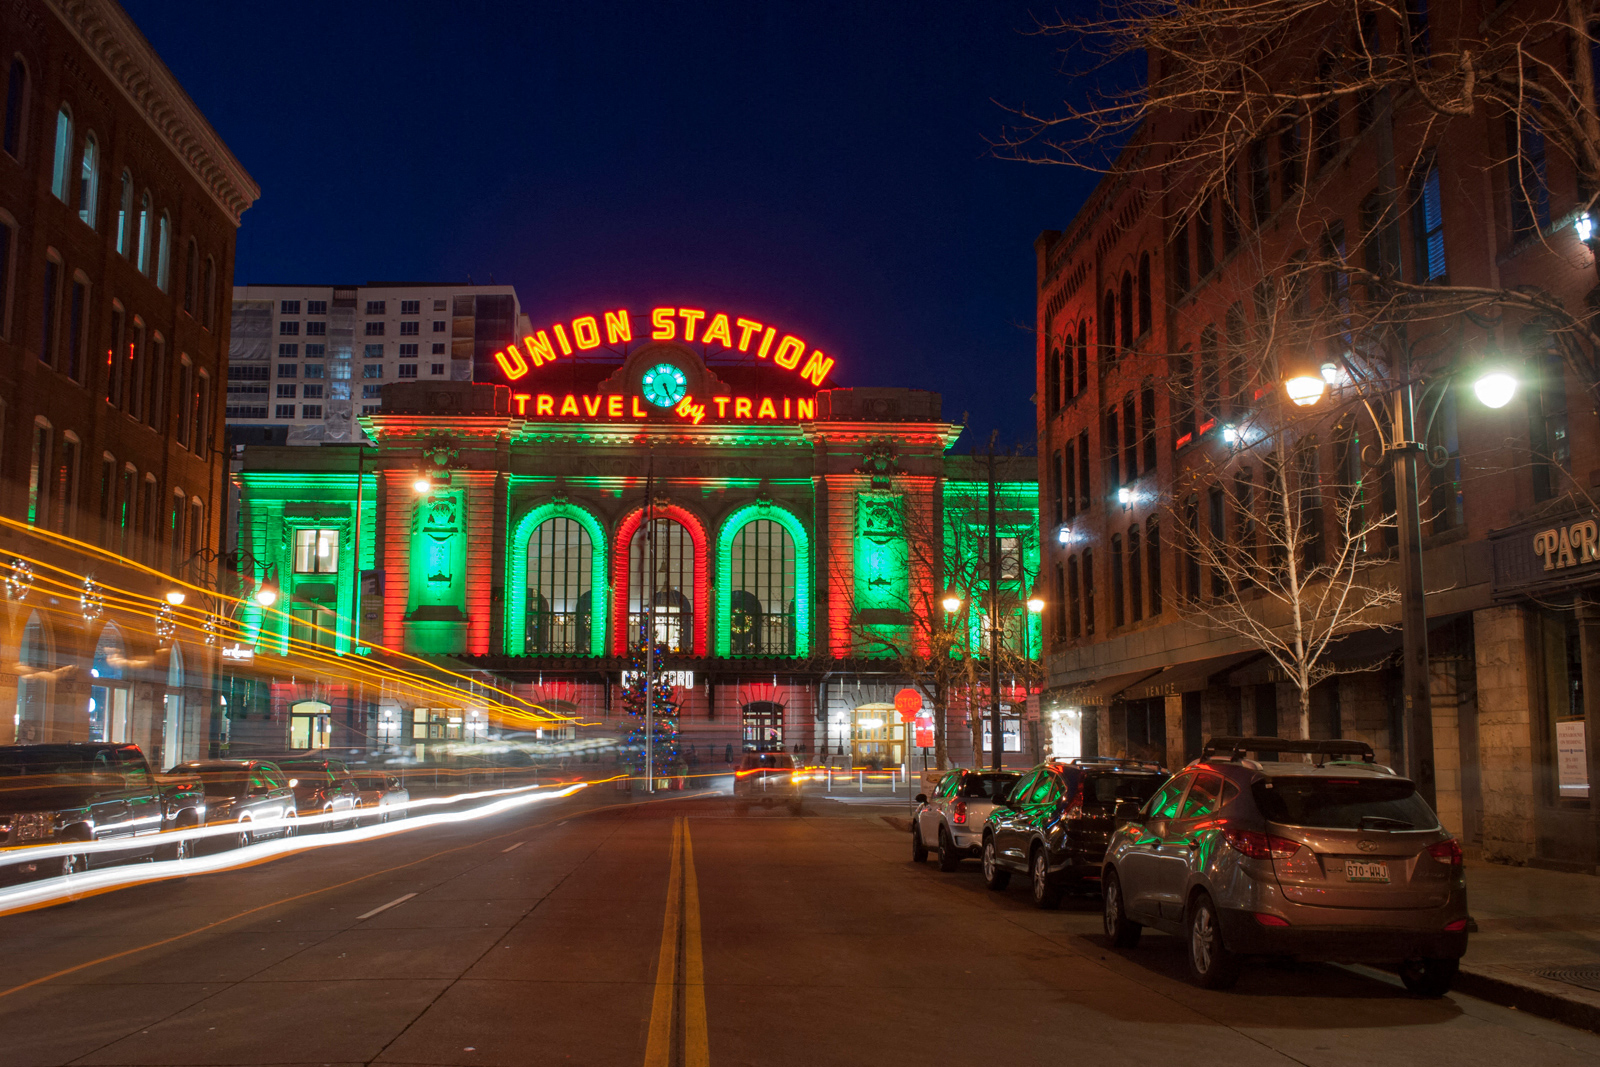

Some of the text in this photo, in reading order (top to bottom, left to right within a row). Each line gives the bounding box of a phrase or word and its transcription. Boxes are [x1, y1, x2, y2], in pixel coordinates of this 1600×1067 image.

[494, 307, 835, 387] UNION STATION
[513, 394, 815, 425] TRAVEL by TRAIN
[1533, 519, 1600, 571] PAR
[621, 670, 694, 690] CRFORD
[1145, 682, 1175, 697] VENICE
[897, 697, 920, 708] STOP
